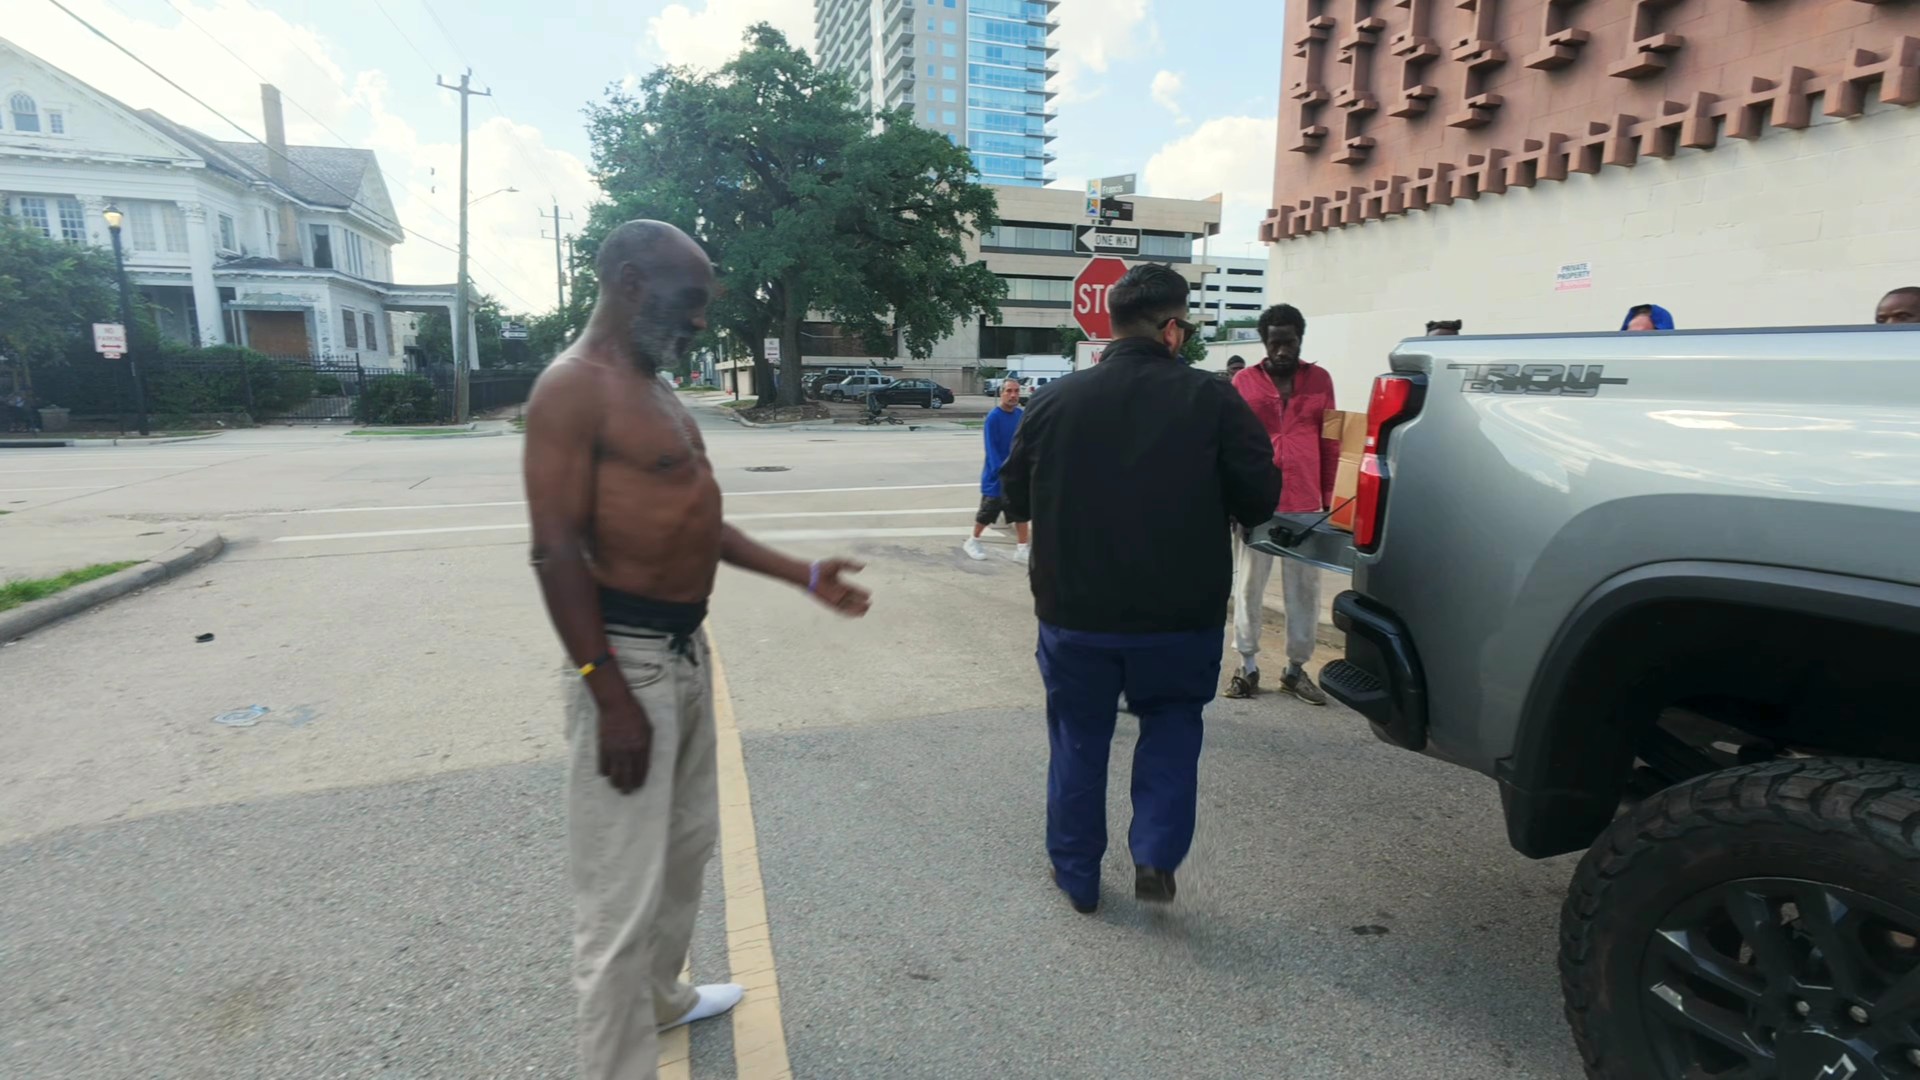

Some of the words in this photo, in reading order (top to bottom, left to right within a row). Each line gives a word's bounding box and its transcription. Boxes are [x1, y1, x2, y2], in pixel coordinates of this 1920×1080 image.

[1102, 185, 1123, 194] Francis
[1095, 234, 1113, 246] ONE
[1116, 235, 1135, 247] WAY
